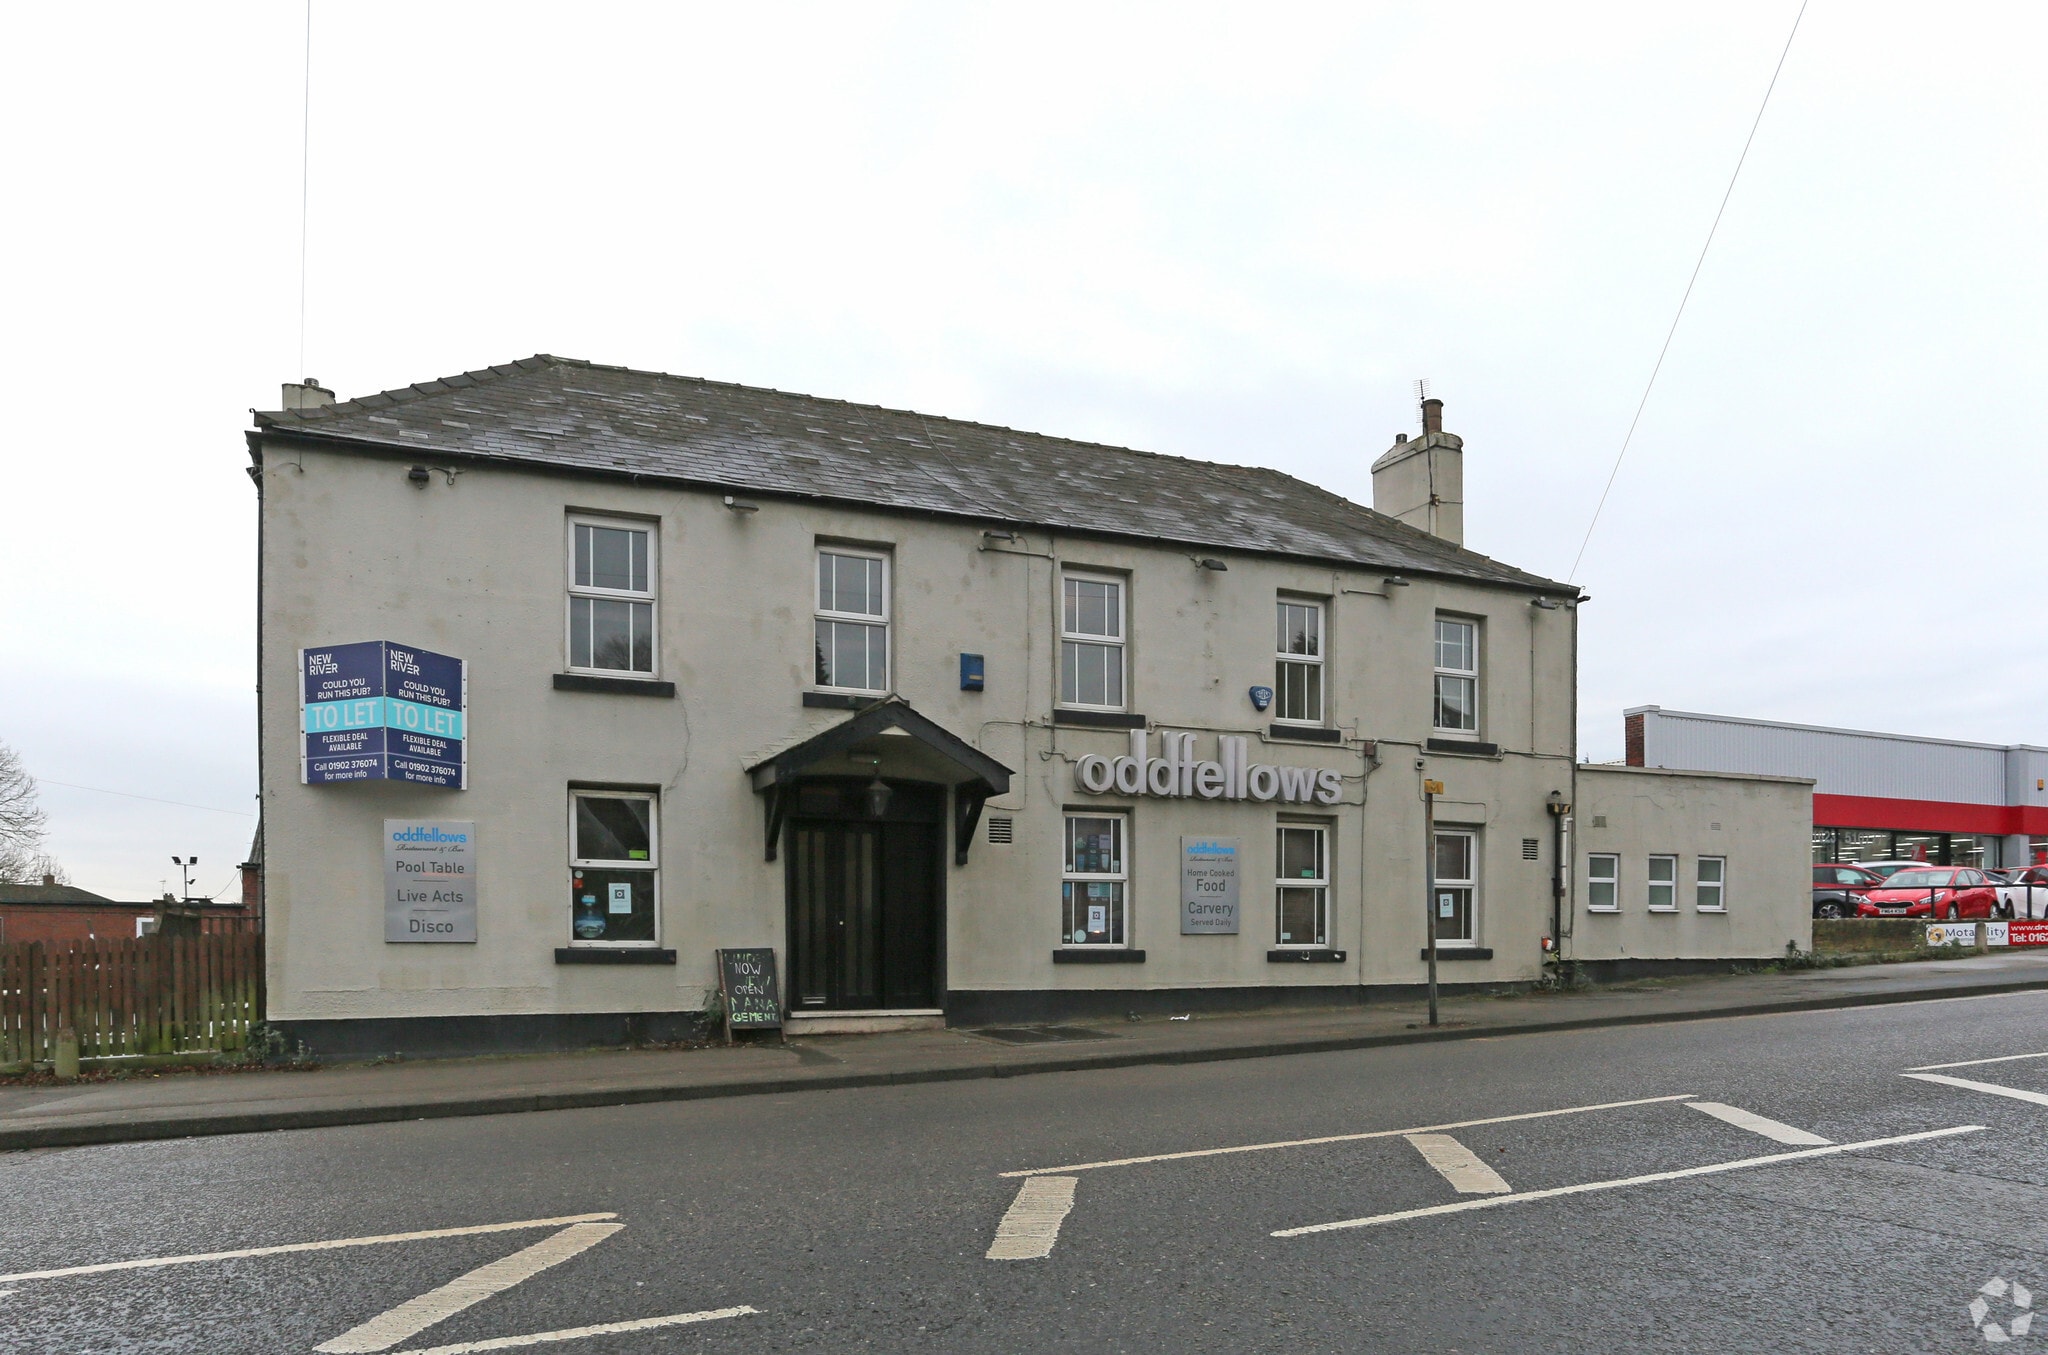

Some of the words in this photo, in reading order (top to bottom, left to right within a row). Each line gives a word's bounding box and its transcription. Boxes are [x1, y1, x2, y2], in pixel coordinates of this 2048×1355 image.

[309, 654, 332, 666] NEW
[390, 649, 414, 664] NEW
[309, 663, 338, 676] RIVER
[390, 660, 420, 676] RIVER
[322, 681, 348, 690] COULD
[349, 678, 366, 687] YOU
[403, 680, 429, 693] COULD
[430, 686, 446, 696] YOU
[317, 691, 334, 700] RUN
[334, 688, 351, 698] THIS
[351, 687, 371, 696] PUB?
[398, 688, 415, 699] RUN
[415, 692, 432, 703] THIS
[432, 696, 451, 707] PUB?
[312, 704, 339, 729] TO
[343, 701, 377, 727] LET
[393, 702, 419, 728] TO
[424, 708, 456, 736] LET
[322, 734, 351, 744] FLEXIBLE
[351, 732, 368, 741] DEAL
[402, 734, 431, 746] FLEXIBLE
[431, 739, 447, 749] DEAL
[328, 742, 363, 752] AVAILABLE
[409, 744, 441, 757] AVAILABLE
[313, 763, 327, 772] Call
[328, 761, 350, 770] 01902
[350, 759, 378, 768] 376074
[394, 760, 408, 769] Call
[408, 762, 430, 773] 01902
[430, 765, 456, 777] 376074
[1075, 729, 1343, 804] oddfellows
[324, 772, 335, 780] for
[335, 771, 353, 779] more
[353, 769, 368, 778] info
[405, 770, 415, 780] for
[415, 774, 433, 783] more
[433, 775, 447, 785] info
[392, 826, 467, 843] oddfellows
[395, 844, 438, 852] Restaurant
[447, 845, 464, 853] Bar
[1187, 841, 1236, 855] oddfellows
[396, 860, 426, 873] Pool
[429, 862, 465, 874] Table
[1187, 869, 1208, 877] Home
[1209, 869, 1235, 877] Cooked
[1196, 878, 1226, 892] Food
[397, 889, 427, 903] Live
[432, 890, 464, 903] Acts
[1188, 901, 1234, 917] Carvery
[409, 919, 454, 933] Disco
[1190, 918, 1214, 926] Served
[1215, 918, 1232, 927] Daily
[1945, 926, 2006, 938] Motality
[2010, 933, 2027, 943] Tel:
[734, 962, 761, 975] NOW
[734, 985, 764, 995] OPEN
